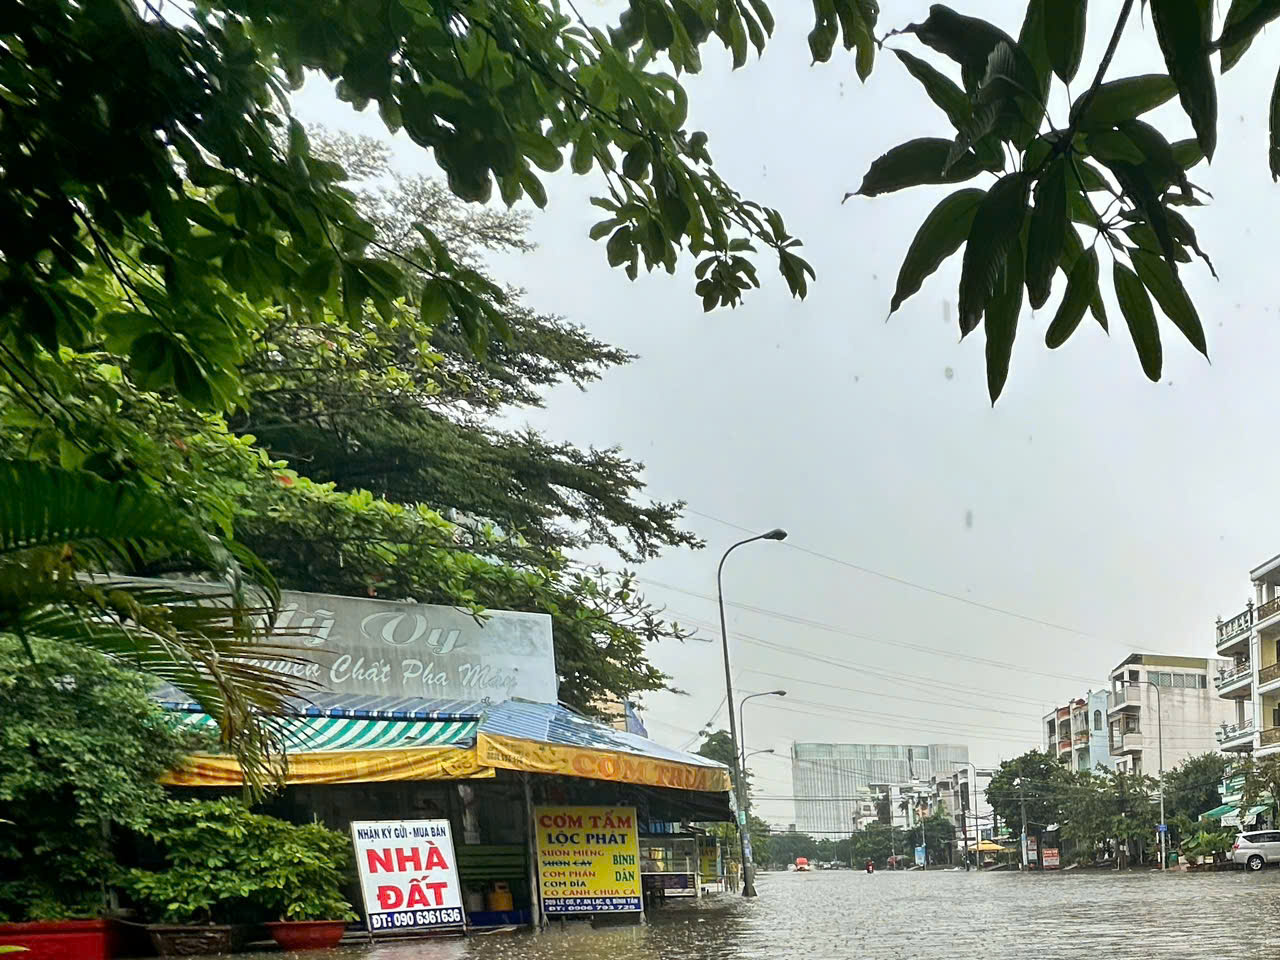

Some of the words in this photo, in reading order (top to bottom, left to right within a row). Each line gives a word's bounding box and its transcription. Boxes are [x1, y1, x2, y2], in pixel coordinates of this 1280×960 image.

[329, 654, 390, 687] Chất
[402, 658, 448, 686] Pha
[540, 812, 584, 829] CƠM
[589, 809, 632, 829] TẤM
[357, 826, 380, 842] NHẬN
[382, 826, 392, 839] KÝ
[413, 827, 429, 838] MUA
[431, 825, 446, 837] BÁN
[547, 830, 580, 847] LỘC
[586, 829, 628, 845] PHÁT
[366, 841, 449, 873] NHÀ
[376, 875, 448, 910] ĐẤT
[372, 914, 392, 928] ĐT:
[394, 912, 414, 926] 090
[416, 909, 461, 925] 6361636
